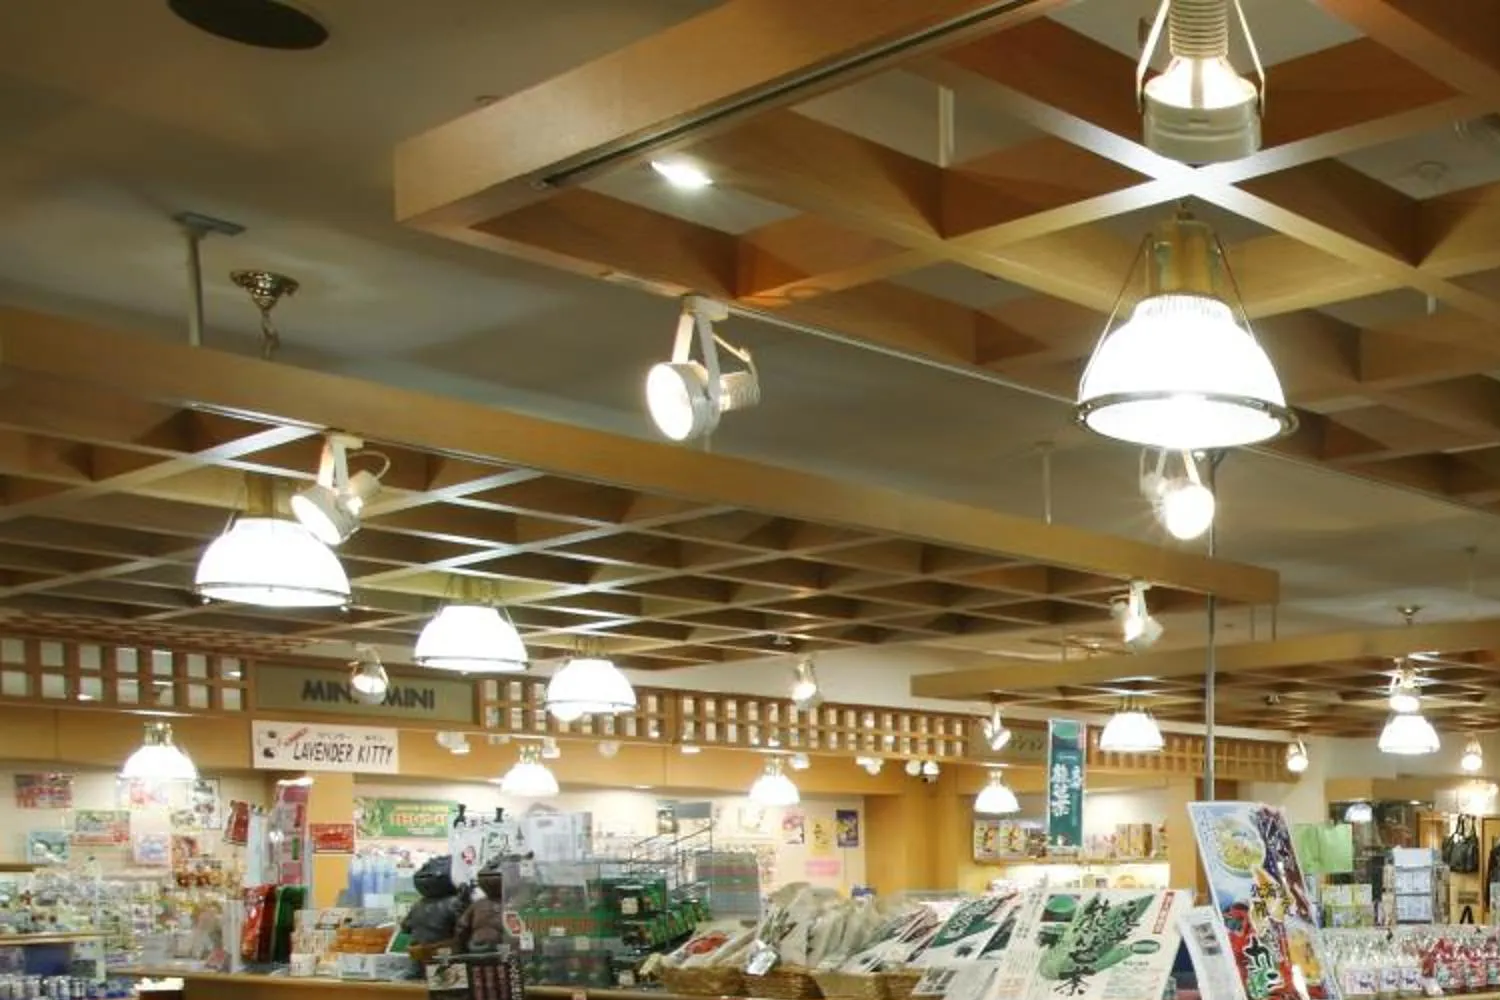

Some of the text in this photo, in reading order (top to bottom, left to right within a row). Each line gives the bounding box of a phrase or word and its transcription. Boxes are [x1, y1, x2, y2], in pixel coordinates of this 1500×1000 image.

[303, 679, 435, 710] MIN MINI
[293, 741, 394, 765] LAVENDER KITTY
